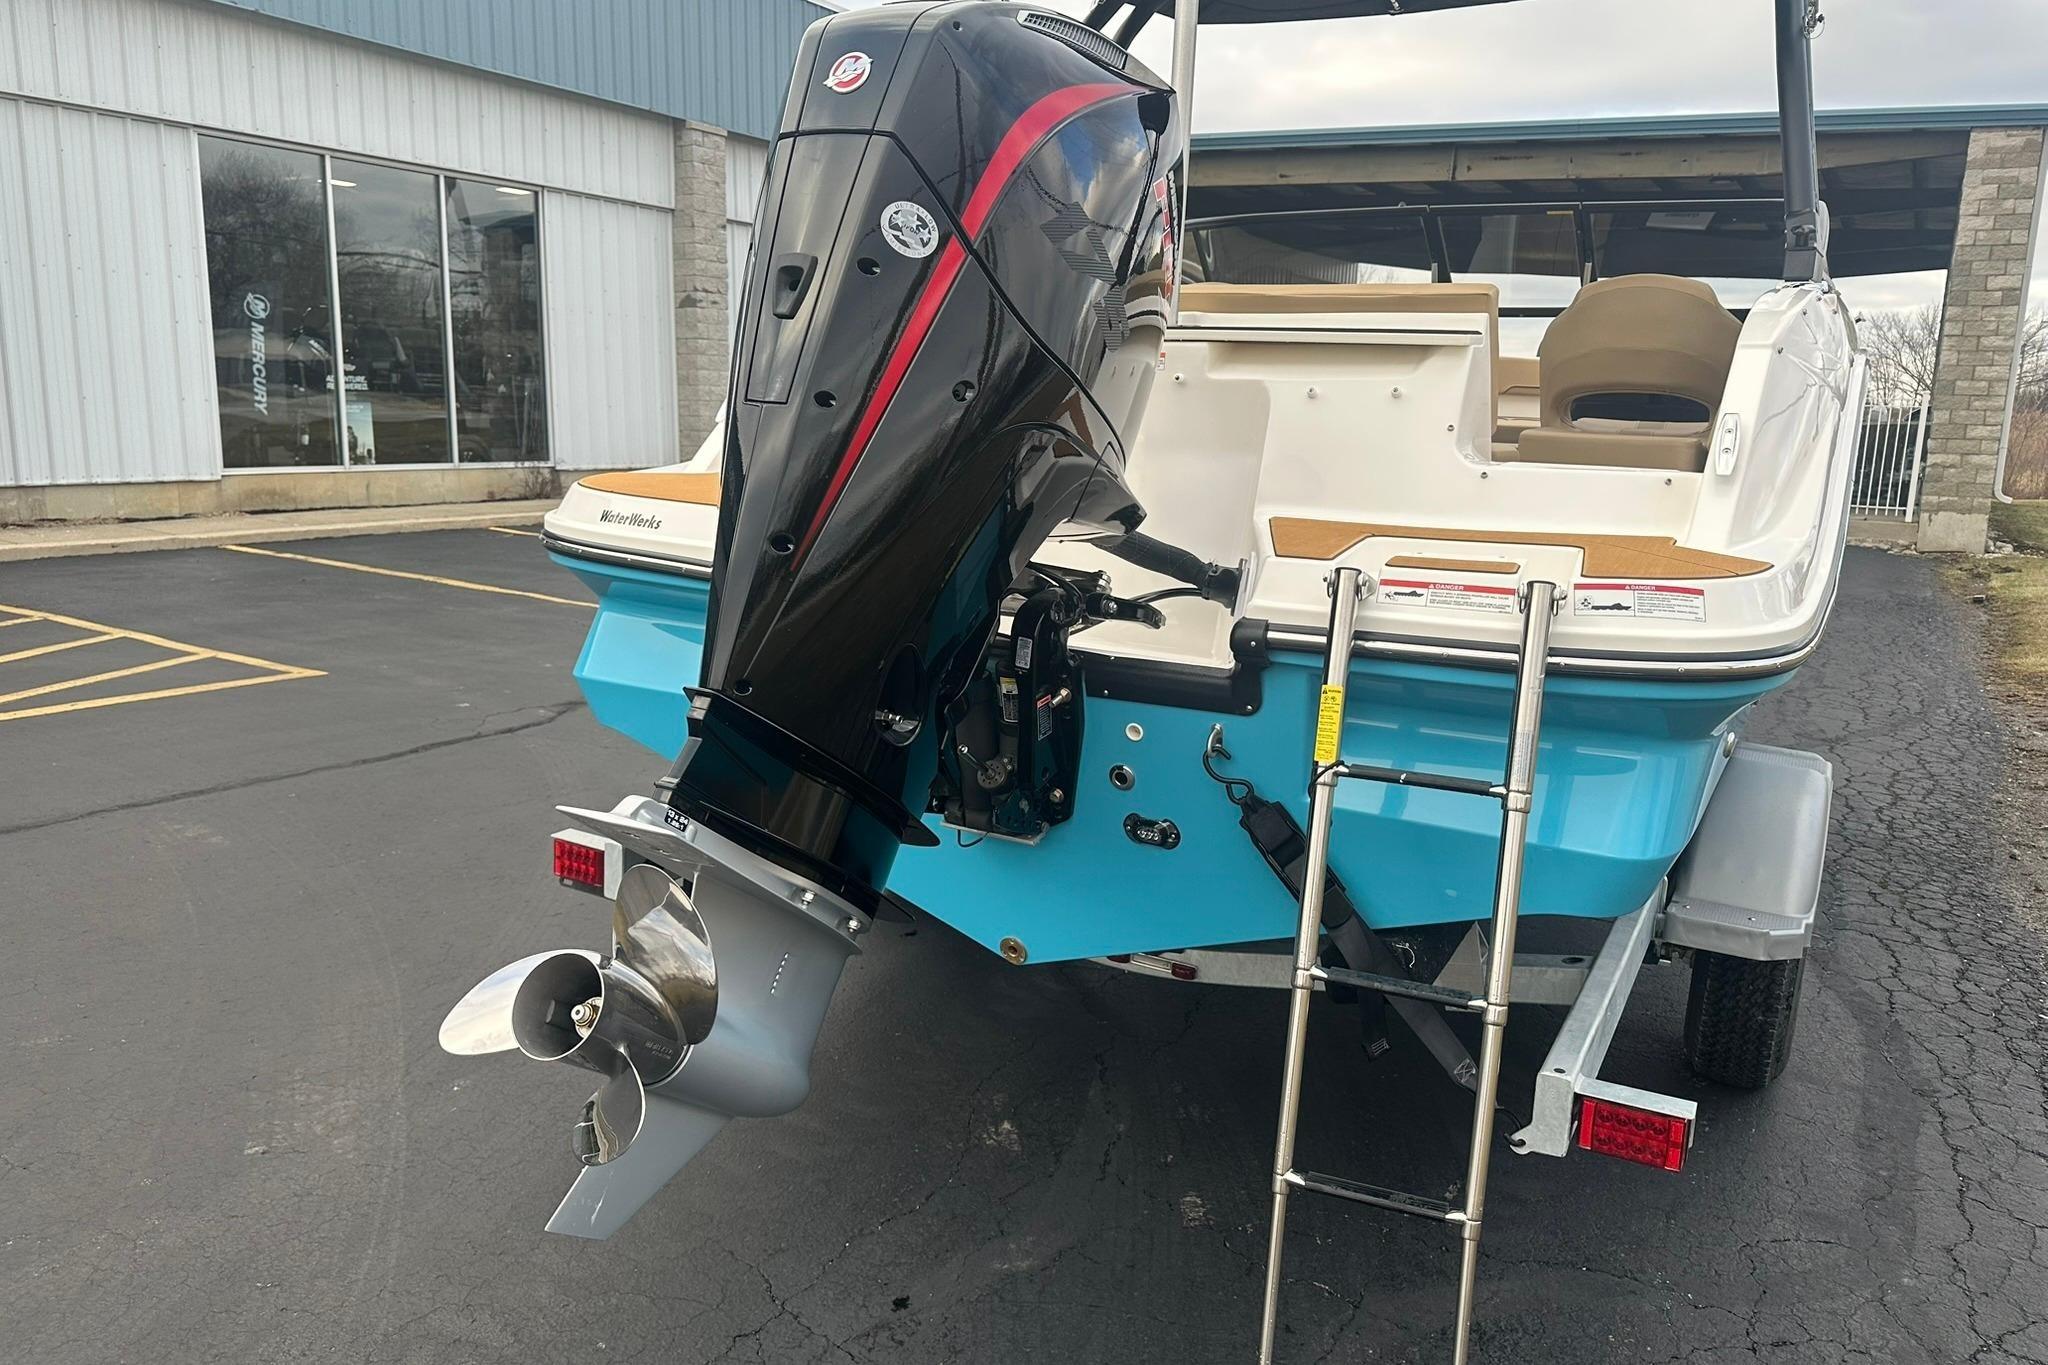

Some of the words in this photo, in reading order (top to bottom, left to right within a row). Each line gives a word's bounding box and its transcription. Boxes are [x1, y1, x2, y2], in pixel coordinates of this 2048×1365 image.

[251, 321, 268, 415] MERCURY
[600, 509, 662, 530] WaterWerks
[1435, 583, 1465, 591] DANGER
